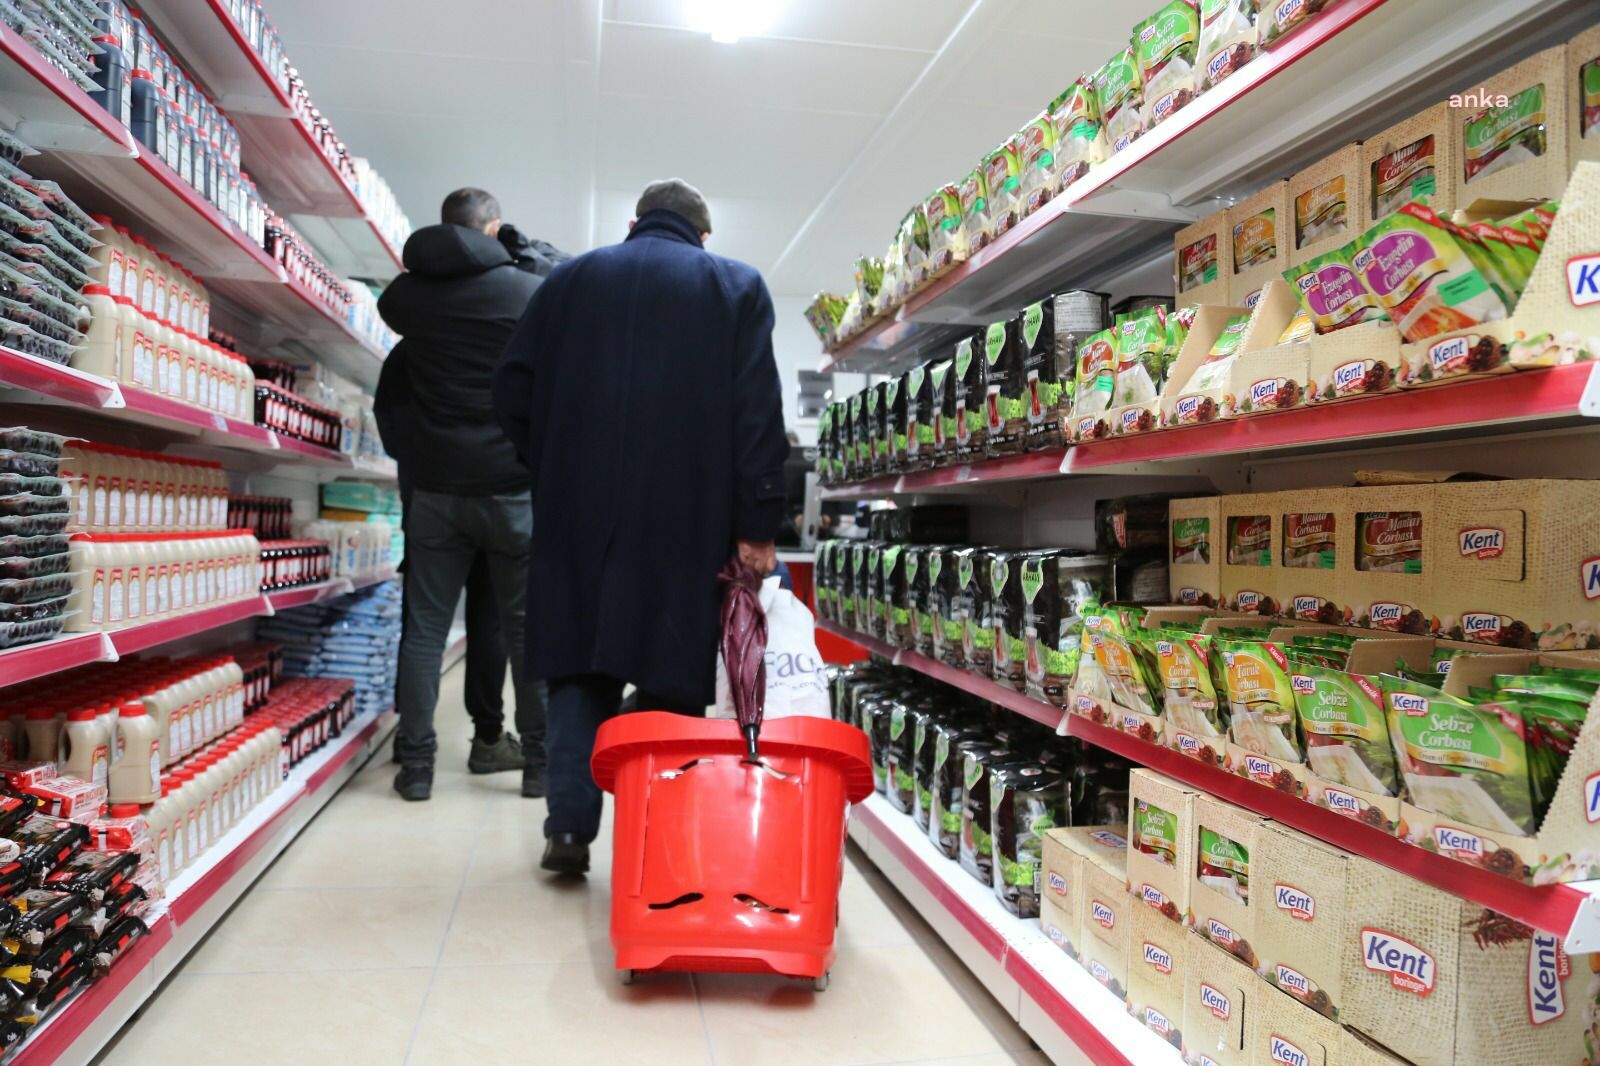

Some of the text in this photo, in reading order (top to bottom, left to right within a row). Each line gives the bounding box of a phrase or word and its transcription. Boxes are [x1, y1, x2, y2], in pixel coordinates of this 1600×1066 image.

[1278, 0, 1302, 21] Ken
[1210, 51, 1228, 76] Kent
[1155, 96, 1171, 117] Kent
[1355, 250, 1373, 269] Kent
[1298, 274, 1319, 291] Kent
[1433, 340, 1464, 364] Kent
[1336, 364, 1362, 385] Kent
[1253, 380, 1276, 399] Kent
[1179, 398, 1196, 414] Kent
[1080, 418, 1094, 432] Kent
[1123, 410, 1137, 423] Kent
[1463, 531, 1500, 551] Kent
[1181, 590, 1196, 600] Kent
[1240, 592, 1256, 604] Kent
[1296, 599, 1317, 611] Kent
[1373, 606, 1399, 619] Kent
[1466, 616, 1497, 630] Kent
[1269, 647, 1285, 664] Klasik
[1437, 662, 1451, 672] Ke
[1293, 677, 1313, 689] Kent
[1358, 679, 1378, 699] Klasik
[1318, 690, 1348, 707] Sebze
[1393, 695, 1426, 710] Kent
[1124, 716, 1139, 727] Kent
[1429, 713, 1474, 734] Sebze
[1179, 735, 1197, 749] Kent
[1249, 759, 1271, 774] Kent
[1329, 792, 1356, 810] Kent
[1440, 830, 1477, 851] Kent
[1050, 874, 1065, 889] Kent
[1144, 887, 1162, 903] Kent
[1278, 888, 1311, 912] Kent
[1094, 904, 1112, 920] Kent
[1211, 922, 1232, 939] Kent
[1146, 946, 1170, 967] Kent
[1367, 935, 1428, 979] Kent
[1279, 968, 1306, 990] Kent
[1393, 973, 1426, 992] boringer
[1534, 935, 1557, 1013] Kent
[1203, 988, 1228, 1012] Kent
[1148, 1010, 1167, 1027] Kent
[1273, 1040, 1305, 1066] Kent
